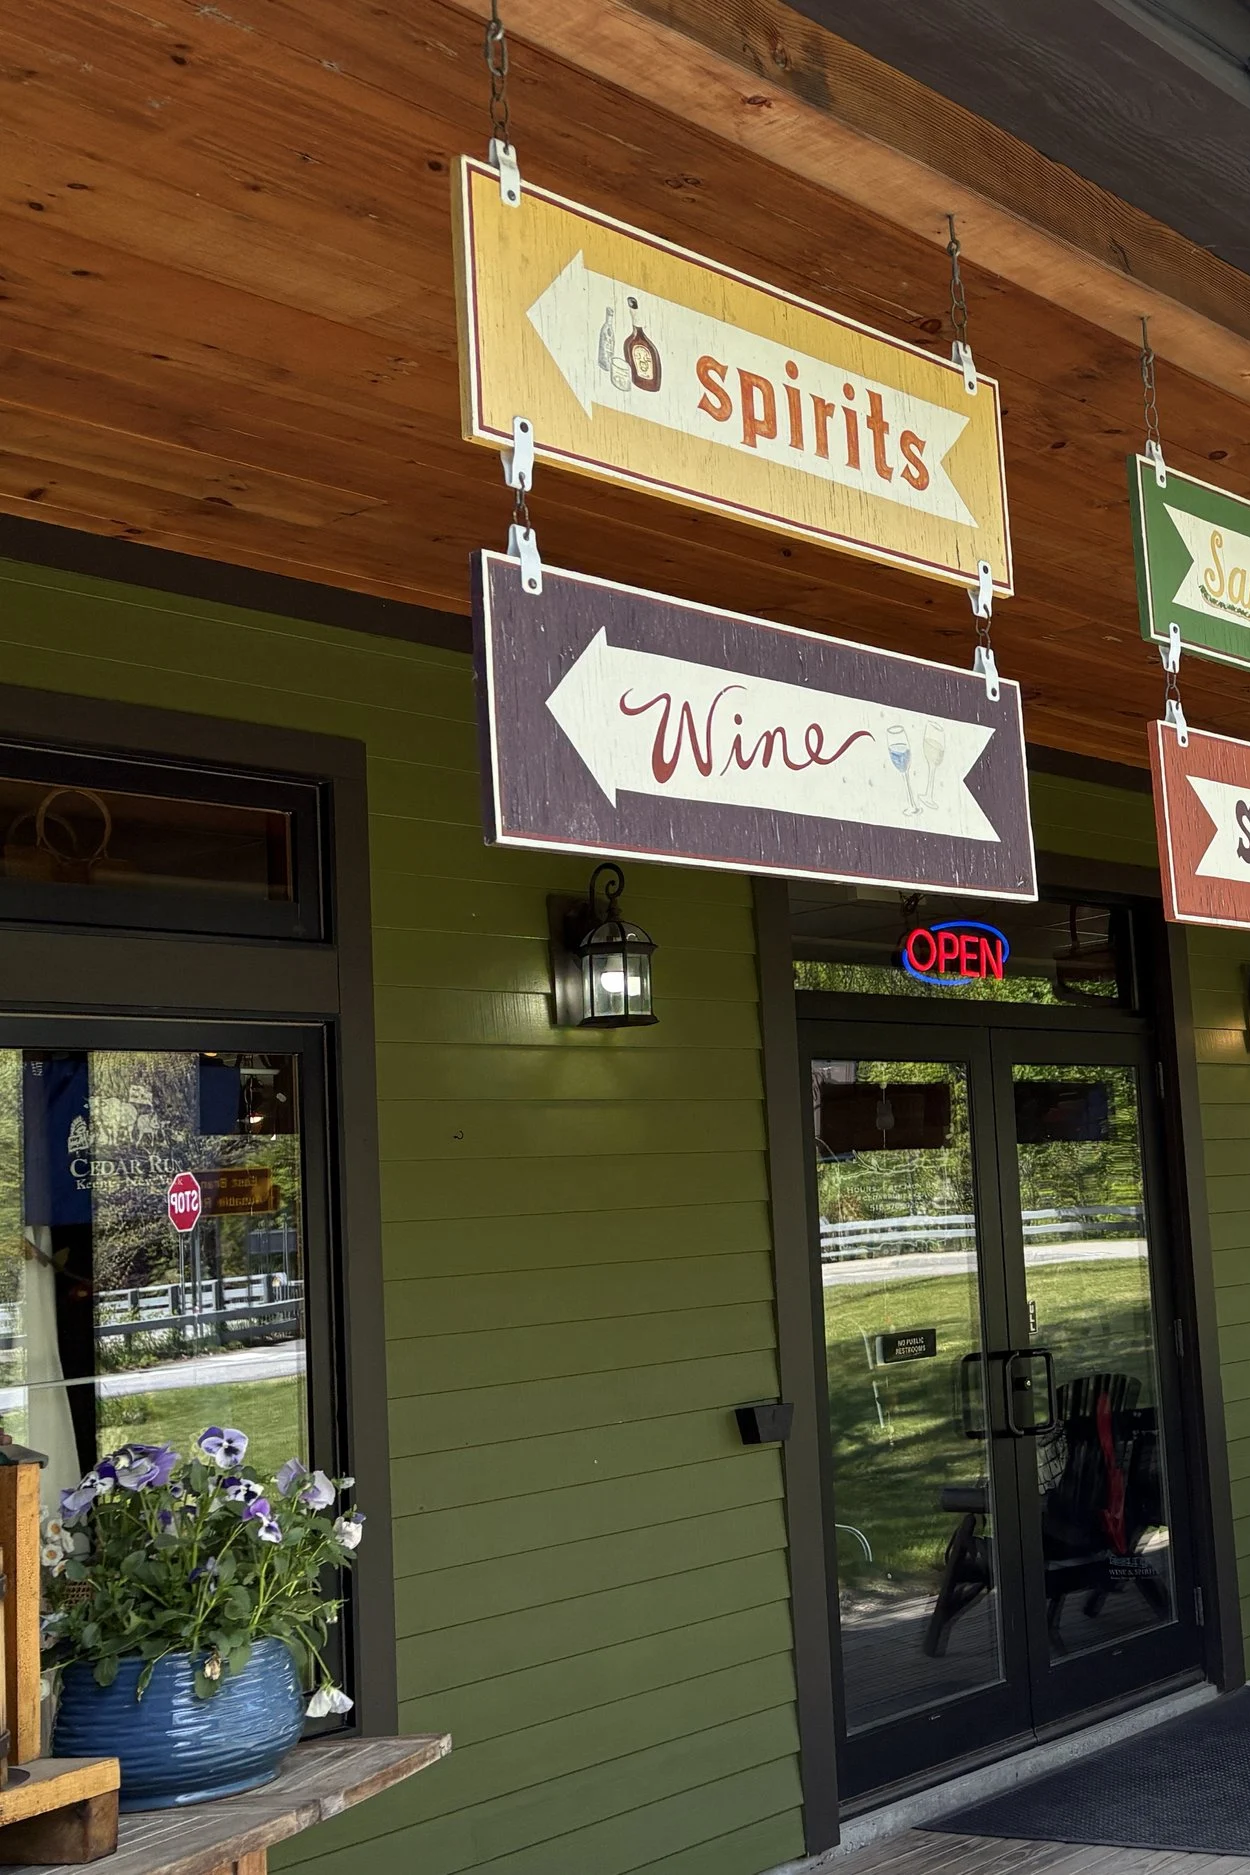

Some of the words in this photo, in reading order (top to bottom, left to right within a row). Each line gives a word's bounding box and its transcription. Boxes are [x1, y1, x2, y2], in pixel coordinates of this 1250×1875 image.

[696, 354, 931, 491] spirits
[619, 684, 875, 784] Wine
[907, 928, 1003, 980] OPEN
[70, 1159, 143, 1177] CEDAR
